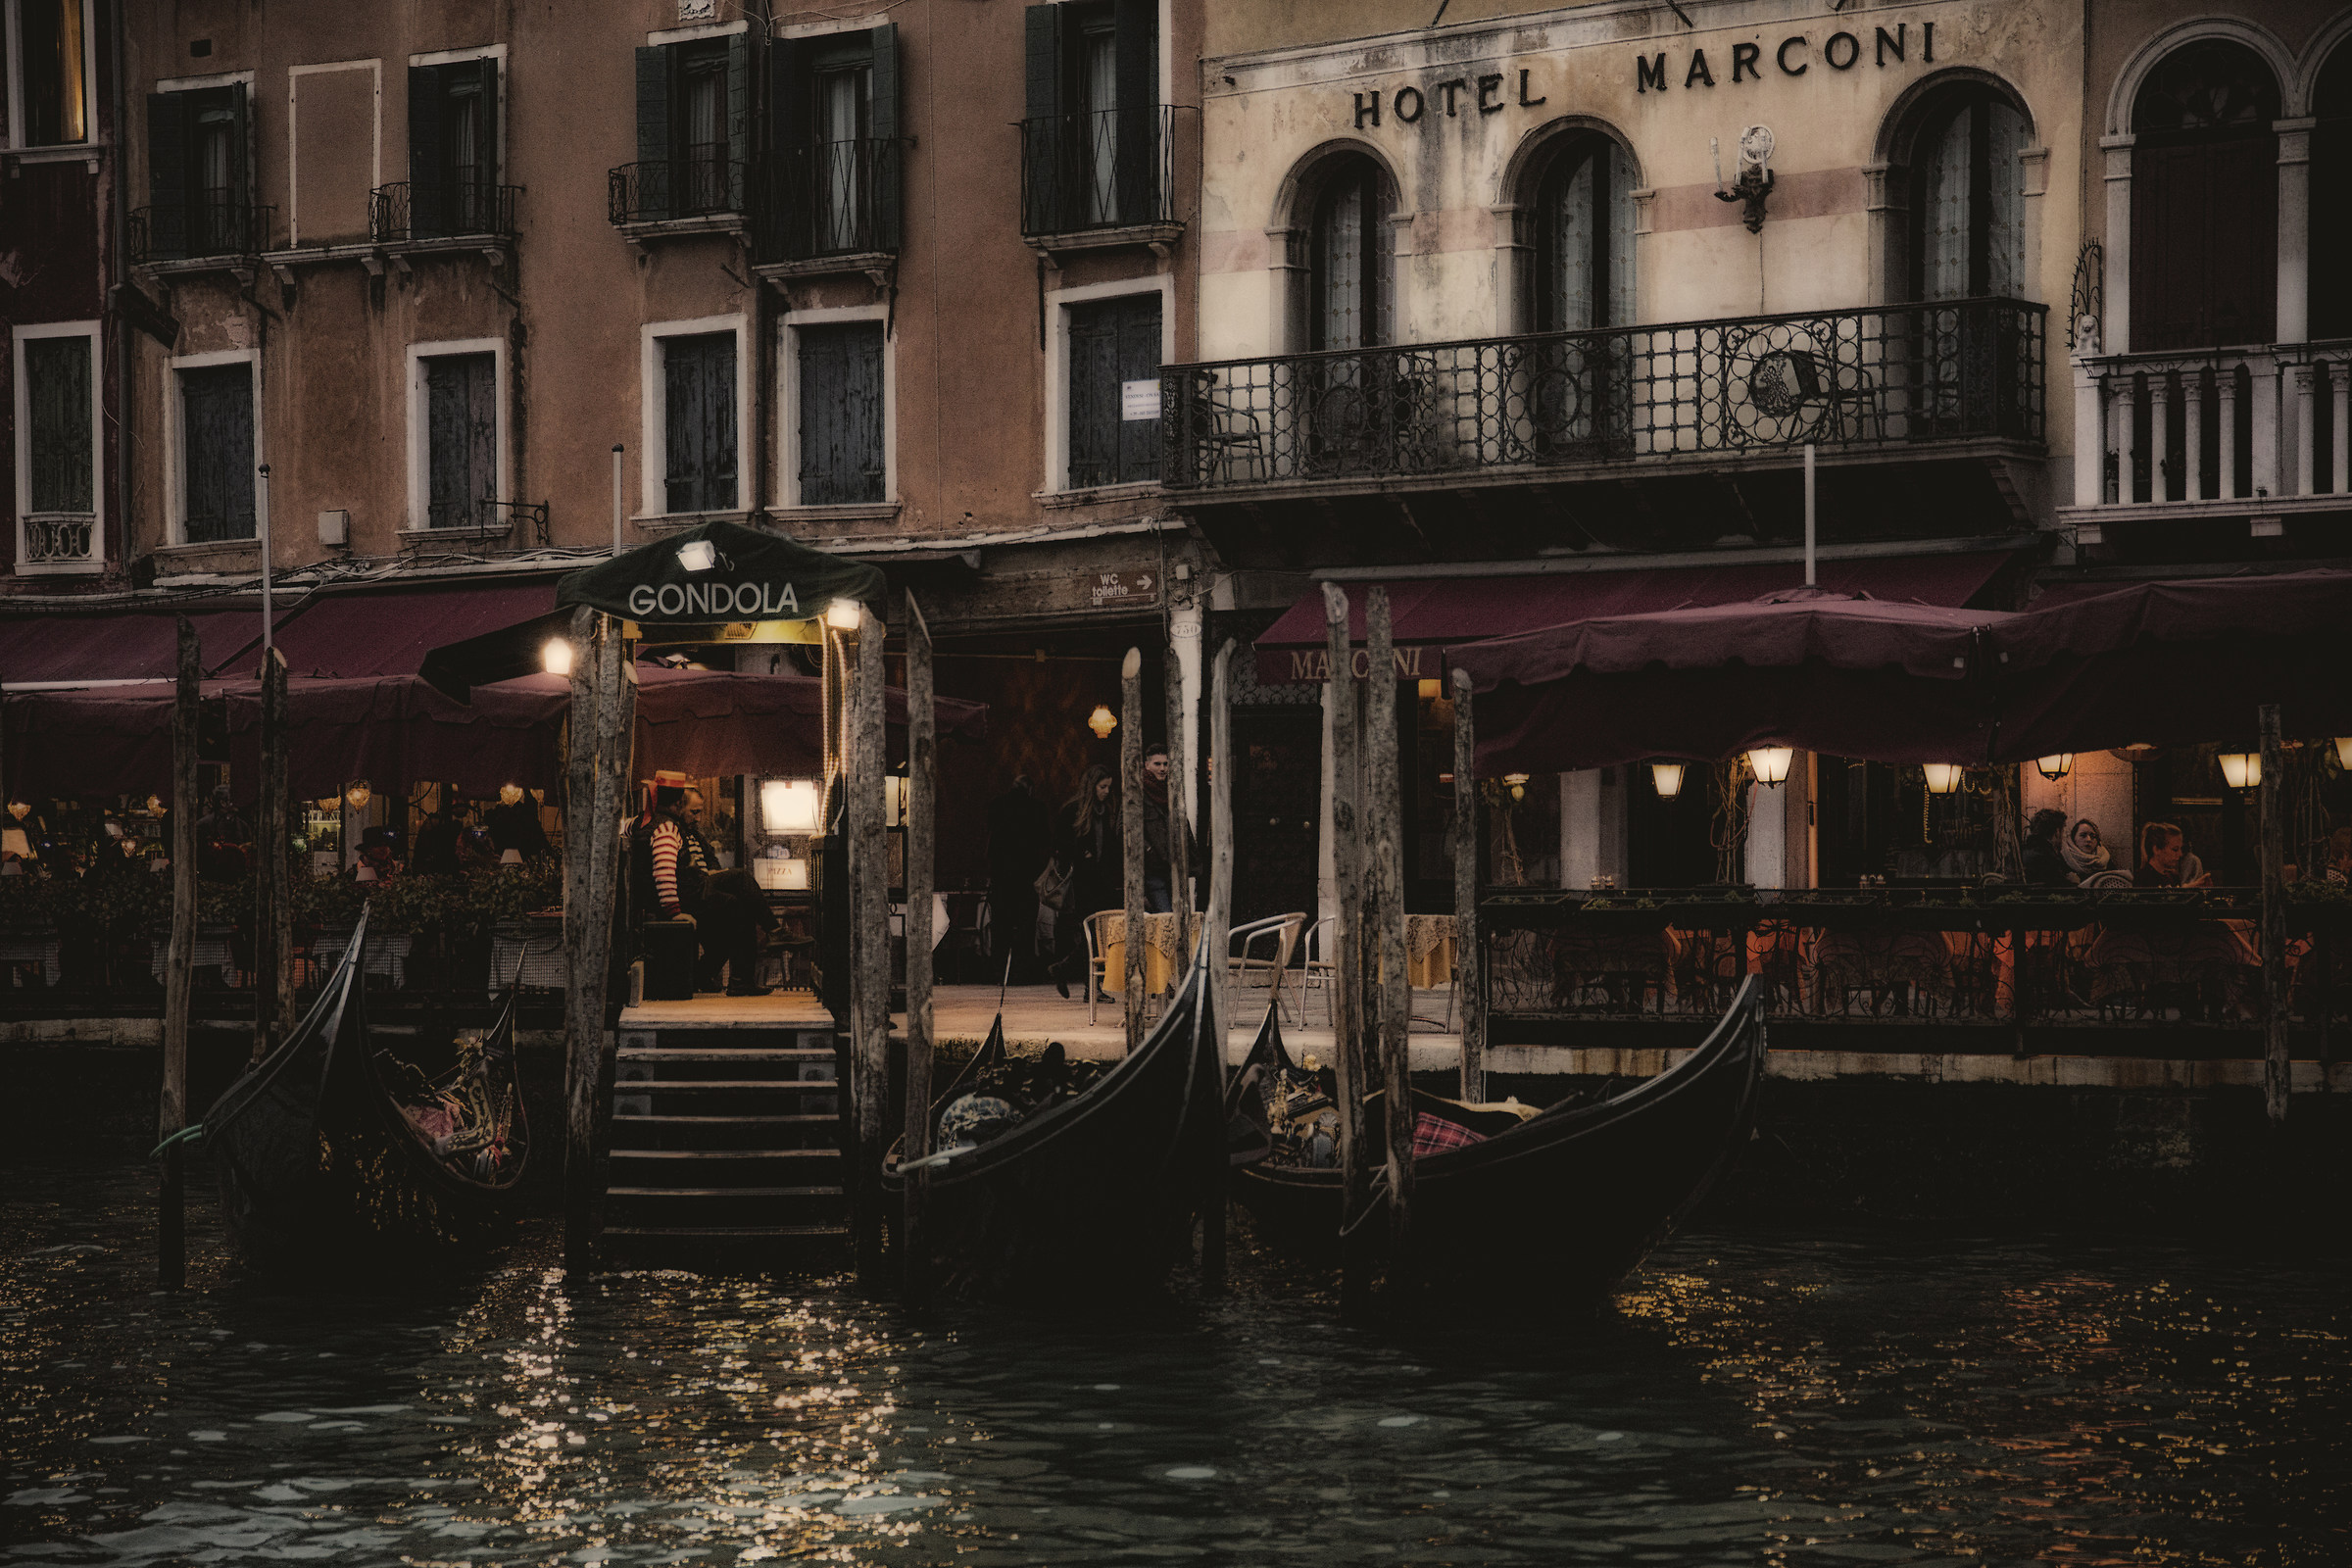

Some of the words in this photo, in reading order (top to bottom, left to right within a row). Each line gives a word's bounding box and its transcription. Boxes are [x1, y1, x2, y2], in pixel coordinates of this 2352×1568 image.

[1353, 69, 1547, 129] HOTEL
[1637, 22, 1935, 93] MARCONI
[1092, 585, 1129, 597] toilette
[1100, 573, 1119, 585] WC
[628, 581, 799, 615] GONDOLA
[1291, 647, 1422, 680] MACNI
